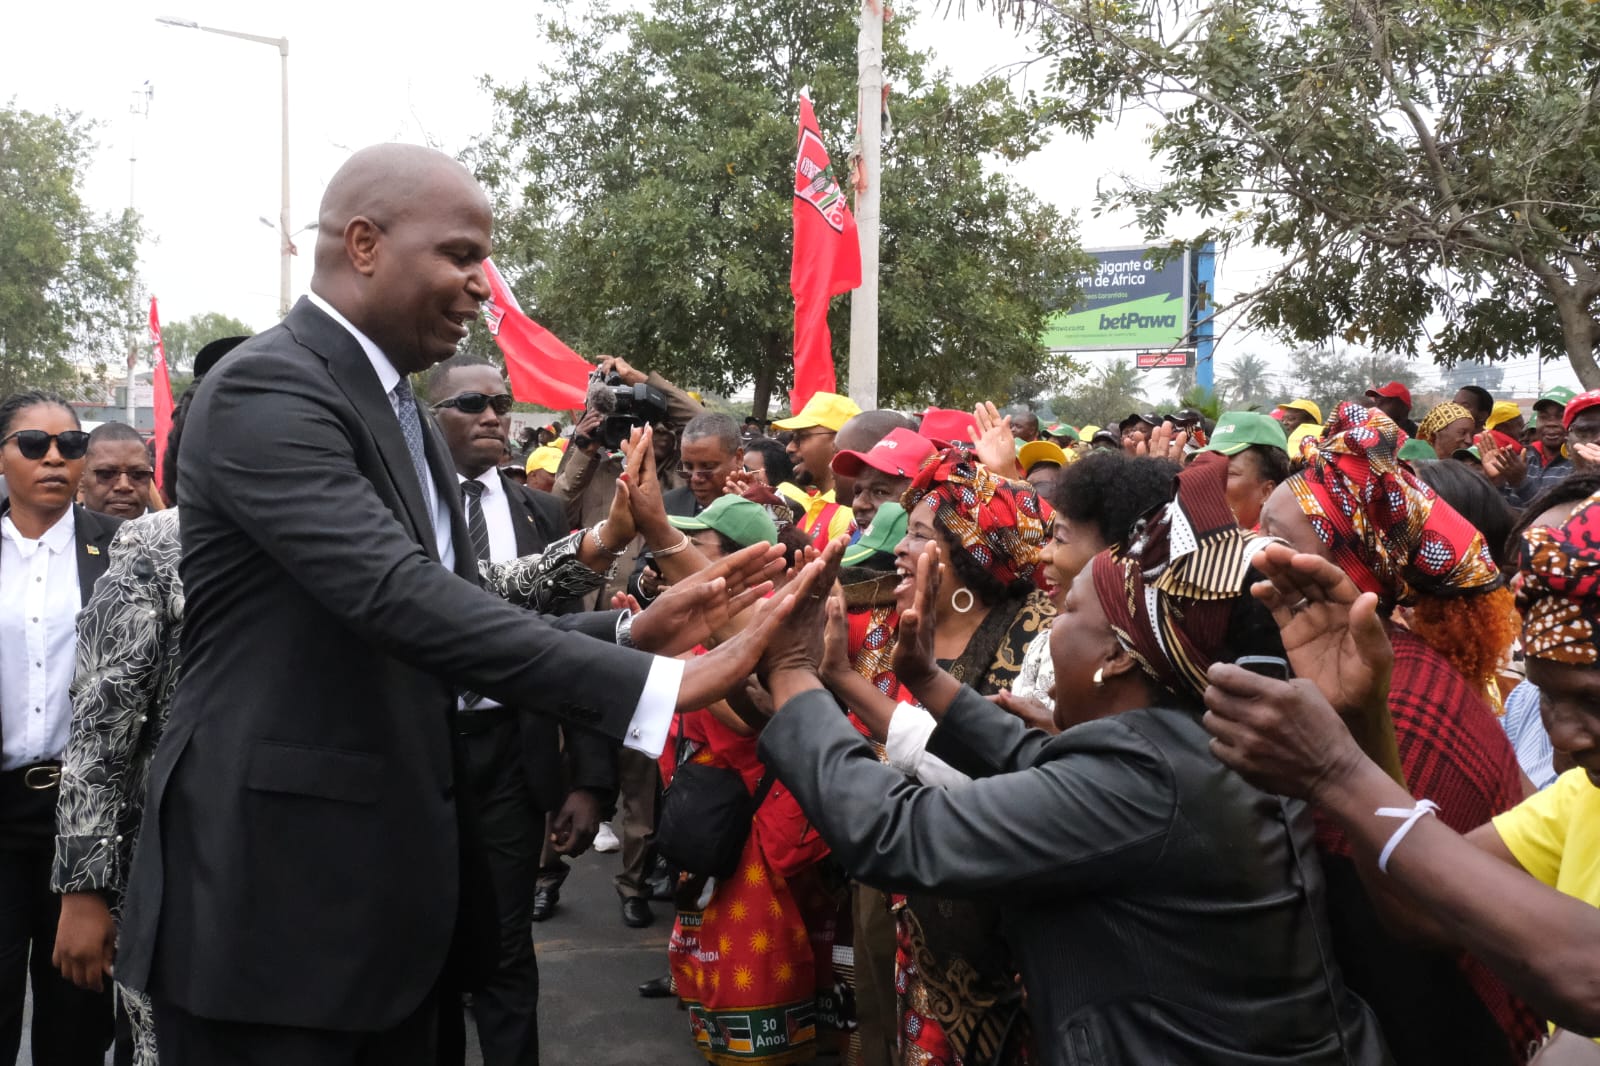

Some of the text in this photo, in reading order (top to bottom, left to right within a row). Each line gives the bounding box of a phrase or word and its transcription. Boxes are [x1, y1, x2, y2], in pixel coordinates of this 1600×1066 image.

[1096, 260, 1141, 276] gigante
[1094, 275, 1110, 287] de
[1099, 312, 1176, 330] betPawa
[761, 1018, 777, 1033] 30
[755, 1033, 786, 1048] Anos
